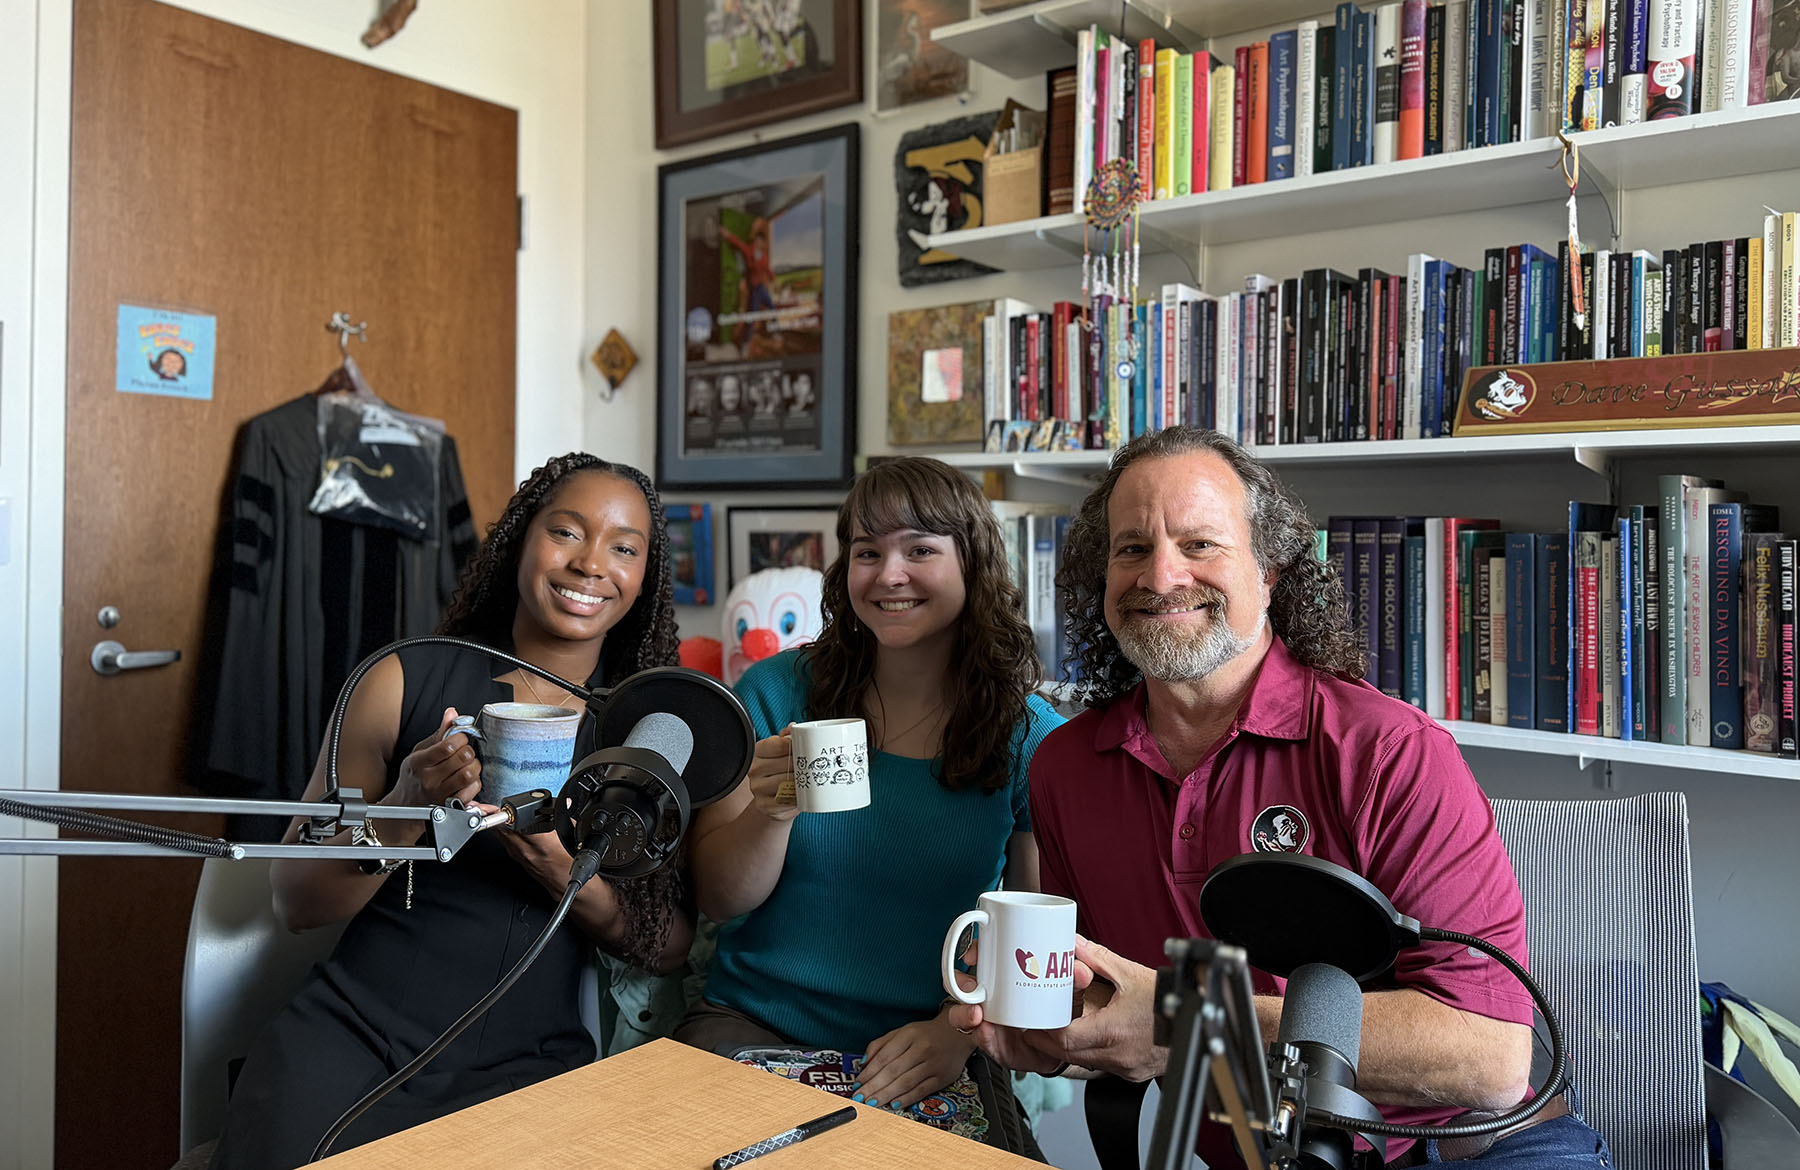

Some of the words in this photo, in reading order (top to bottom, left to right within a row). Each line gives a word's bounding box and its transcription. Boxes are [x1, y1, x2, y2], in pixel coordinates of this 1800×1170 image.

[1554, 10, 1564, 47] COURAGE
[1662, 4, 1671, 48] Psychotherapy
[1674, 22, 1682, 47] Practice
[1280, 49, 1289, 65] Art
[1554, 49, 1562, 58] TO
[1726, 58, 1735, 72] OF
[1553, 60, 1562, 90] CREATE
[1608, 62, 1616, 83] Killers
[1430, 91, 1437, 100] OF
[1530, 63, 1546, 111] Executioner
[1724, 76, 1735, 102] HATE
[1275, 67, 1290, 140] Psychotherapy
[1429, 102, 1437, 141] CREATIVITY
[1141, 128, 1149, 143] Art
[1140, 146, 1149, 184] Therapy
[1737, 256, 1746, 276] Group
[1691, 267, 1700, 292] Therapy
[1737, 278, 1746, 300] Analytic
[1507, 274, 1517, 321] IDENTITY
[1654, 292, 1661, 301] AS
[1724, 287, 1732, 307] MILITARY
[1691, 306, 1699, 324] Anger
[1723, 308, 1732, 330] VETERANS
[1736, 314, 1745, 338] Therapy
[1507, 323, 1516, 344] AND
[1752, 324, 1758, 333] TO
[1506, 346, 1515, 363] ART
[1552, 380, 1648, 406] Dave
[1633, 525, 1641, 546] never
[1359, 553, 1369, 574] THE
[1385, 553, 1395, 574] THE
[1633, 548, 1641, 562] saw
[1692, 556, 1700, 571] THE
[1716, 518, 1729, 603] RESCUING
[1756, 547, 1771, 578] Felix
[1781, 546, 1793, 569] JUDY
[1480, 564, 1490, 613] HELGA'S
[1633, 564, 1641, 594] another
[1647, 582, 1659, 600] LAST
[1667, 563, 1675, 606] HOLOCAUST
[1692, 573, 1700, 590] ART
[1782, 570, 1793, 610] CHICAGO
[1603, 599, 1611, 611] MY
[1692, 592, 1700, 604] OF
[1359, 578, 1369, 650] HOLOCAUST
[1385, 579, 1395, 651] HOLOCAUST
[1647, 603, 1659, 631] TRACES
[1668, 607, 1676, 638] MUSEUM
[1692, 605, 1700, 634] JEWISH
[1716, 609, 1729, 632] DA
[1756, 583, 1771, 658] Nussbaum
[1480, 621, 1490, 662] DIARY
[1668, 640, 1676, 648] IN
[1782, 624, 1794, 676] HOLOCAUST
[1603, 653, 1611, 686] KEEPER
[1692, 638, 1700, 677] CHILDREN
[1716, 638, 1729, 687] VINCI
[1668, 649, 1676, 698] WASHINGTON
[1782, 680, 1794, 721] PROJECT
[820, 746, 844, 755] ART
[808, 1071, 856, 1083] FSU
